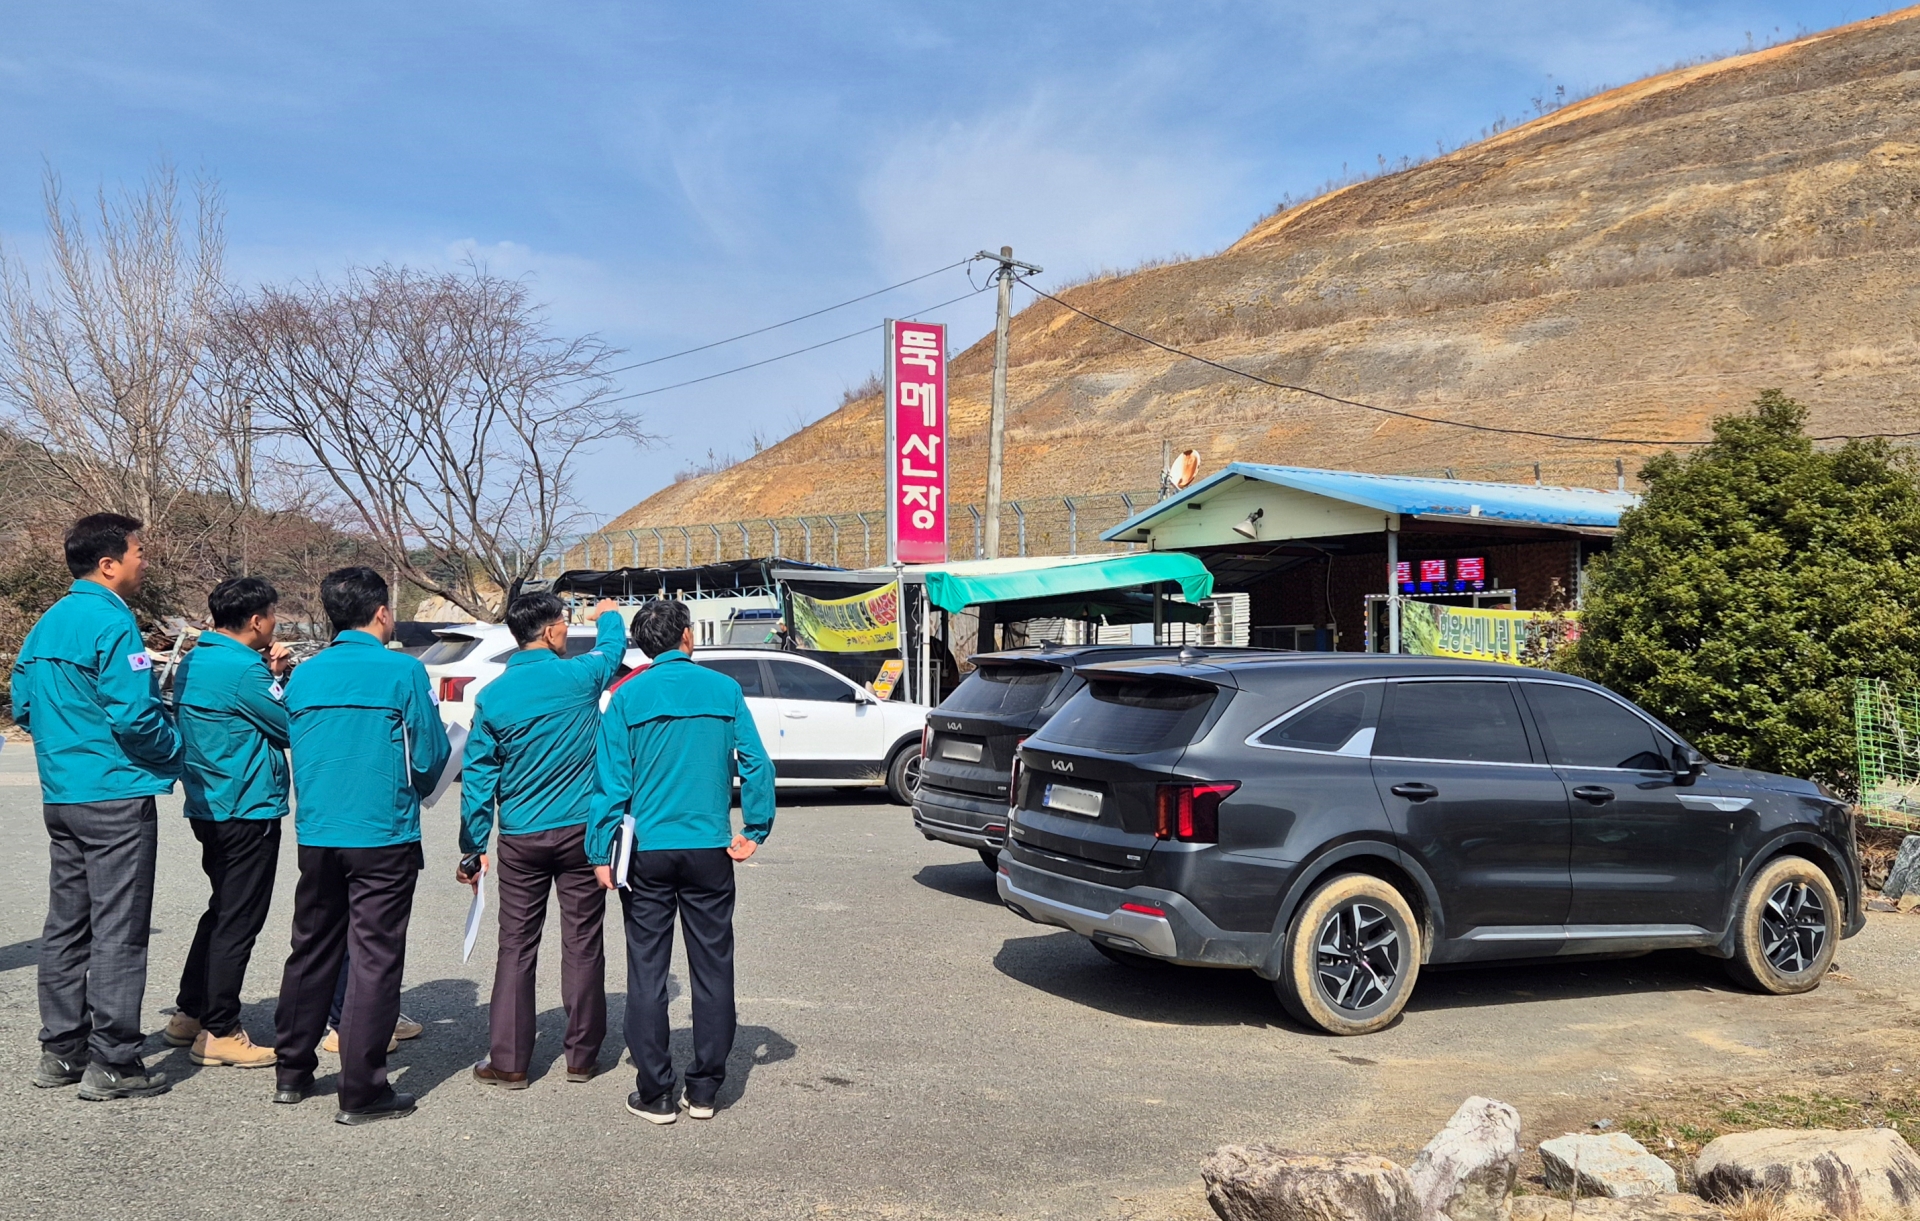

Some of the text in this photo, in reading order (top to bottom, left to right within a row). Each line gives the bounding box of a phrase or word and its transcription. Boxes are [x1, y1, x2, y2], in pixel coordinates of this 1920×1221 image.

[900, 330, 941, 529] 뚝메산장
[947, 721, 962, 731] KIA
[1051, 759, 1074, 773] KIA
